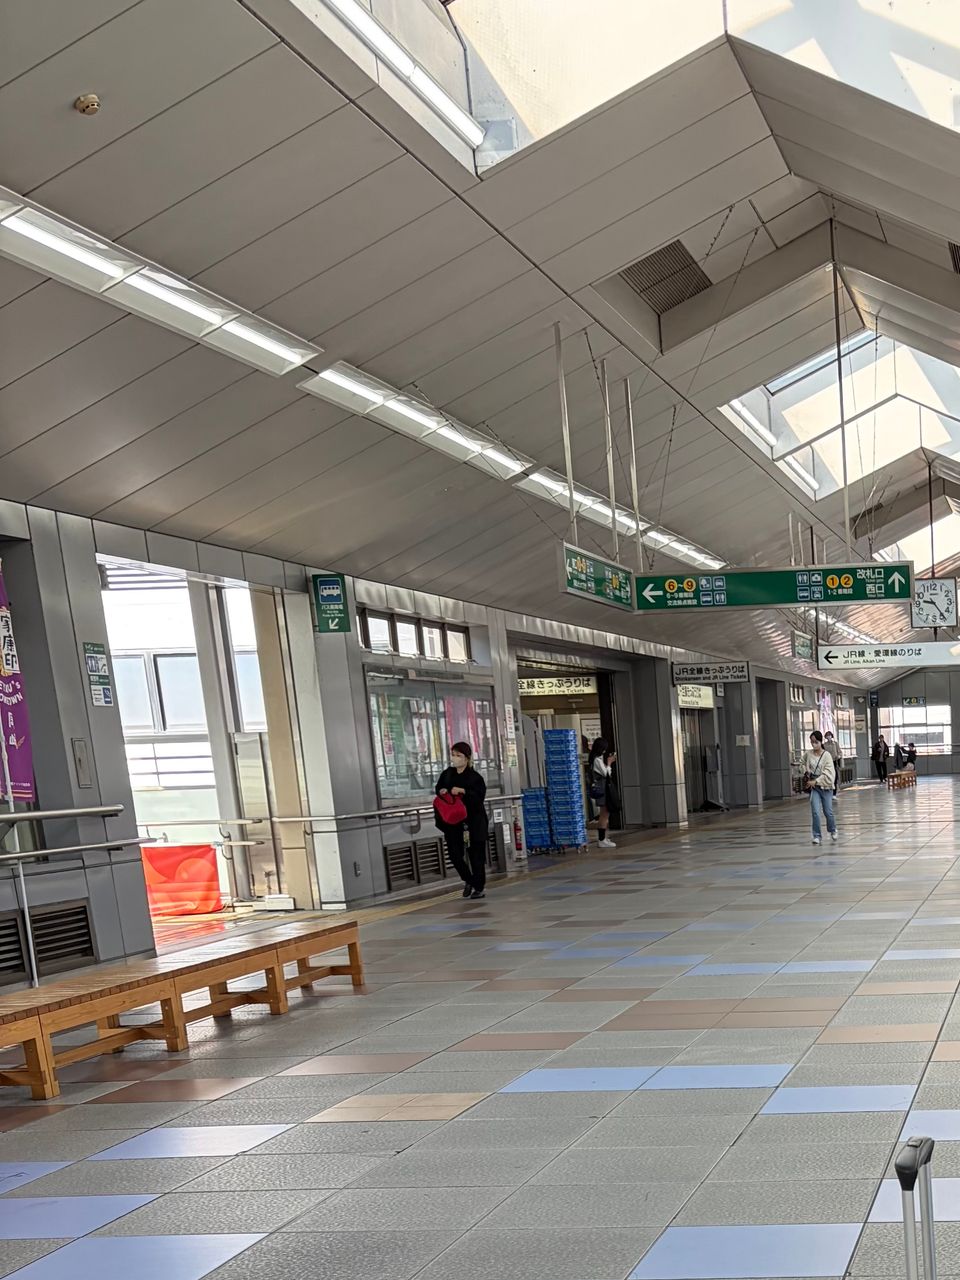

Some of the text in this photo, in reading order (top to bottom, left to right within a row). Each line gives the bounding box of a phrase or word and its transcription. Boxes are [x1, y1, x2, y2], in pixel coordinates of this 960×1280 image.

[856, 568, 884, 579] 改札口
[866, 583, 885, 594] 西口
[915, 600, 921, 608] 9
[946, 598, 952, 606] 3
[945, 606, 950, 614] 4
[675, 666, 745, 676] JR全線きっぷうりば
